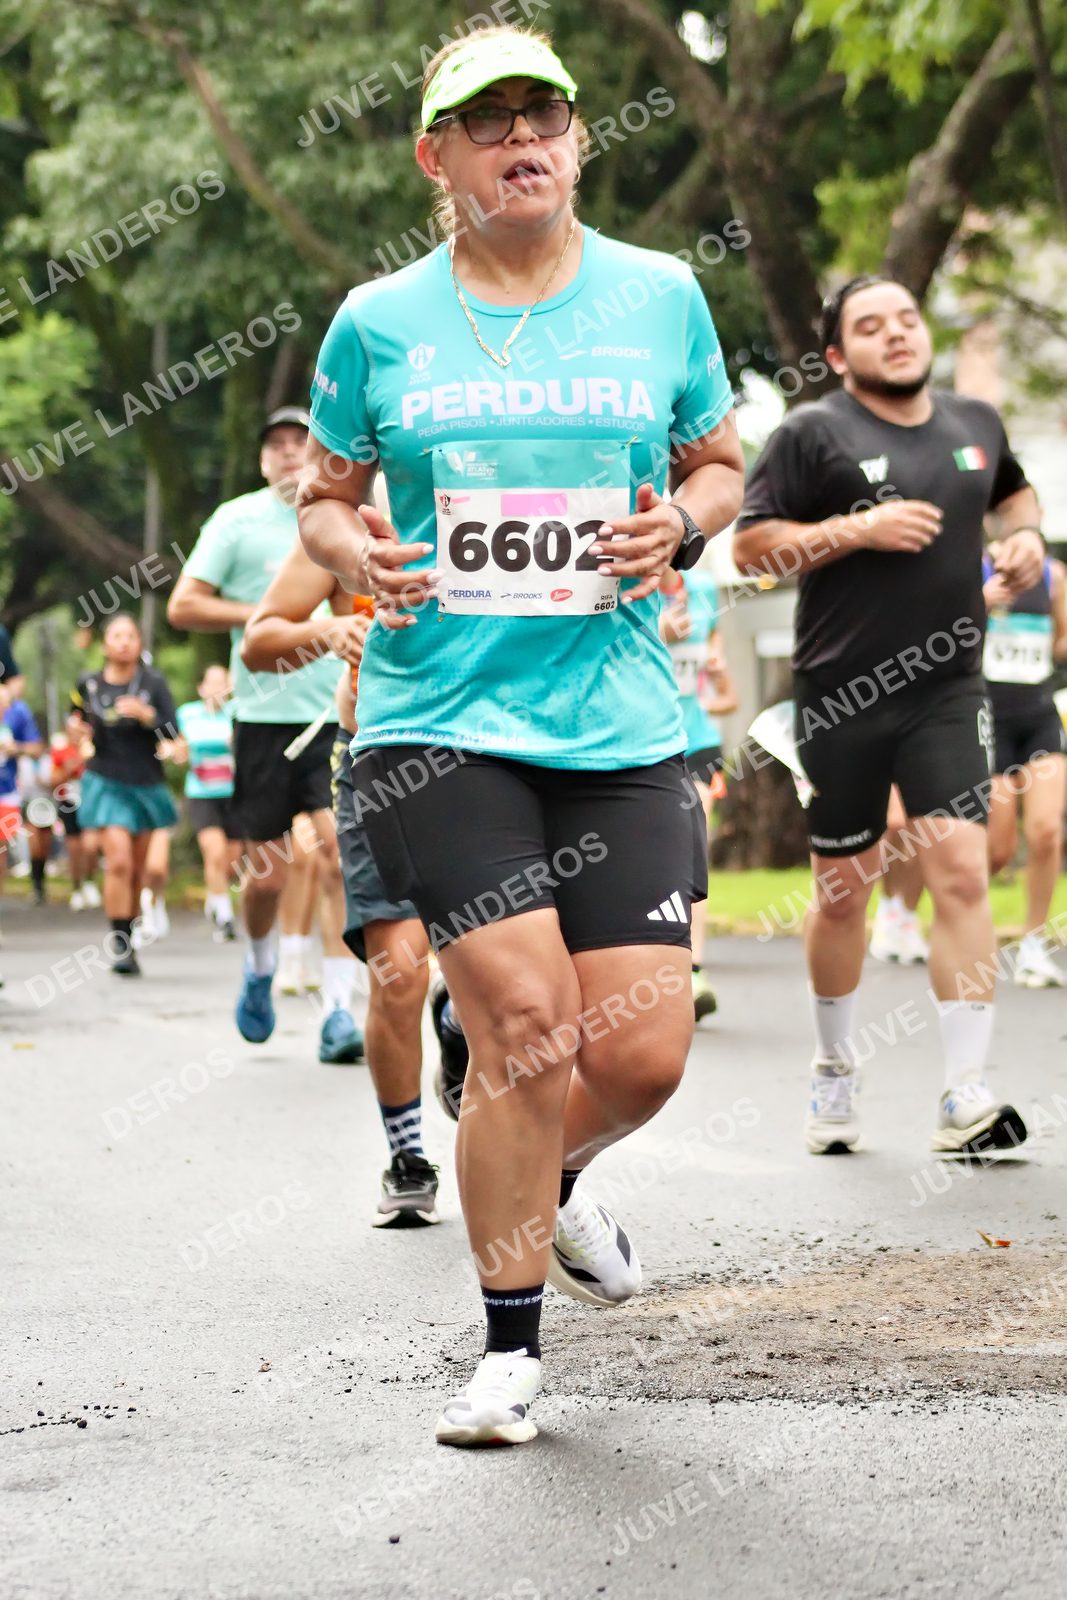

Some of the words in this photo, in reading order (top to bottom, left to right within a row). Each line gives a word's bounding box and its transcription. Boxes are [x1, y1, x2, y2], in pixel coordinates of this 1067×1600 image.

[591, 345, 652, 360] BROOKS
[402, 378, 656, 430] PERDURA
[417, 423, 448, 439] PEGA
[449, 418, 487, 430] PISOS
[496, 416, 585, 427] JUNTEADORES
[595, 418, 647, 432] ESTUCOS
[449, 520, 615, 572] 6602
[447, 589, 492, 599] PERDURA
[512, 592, 543, 600] BROOKS
[594, 601, 615, 611] 6602
